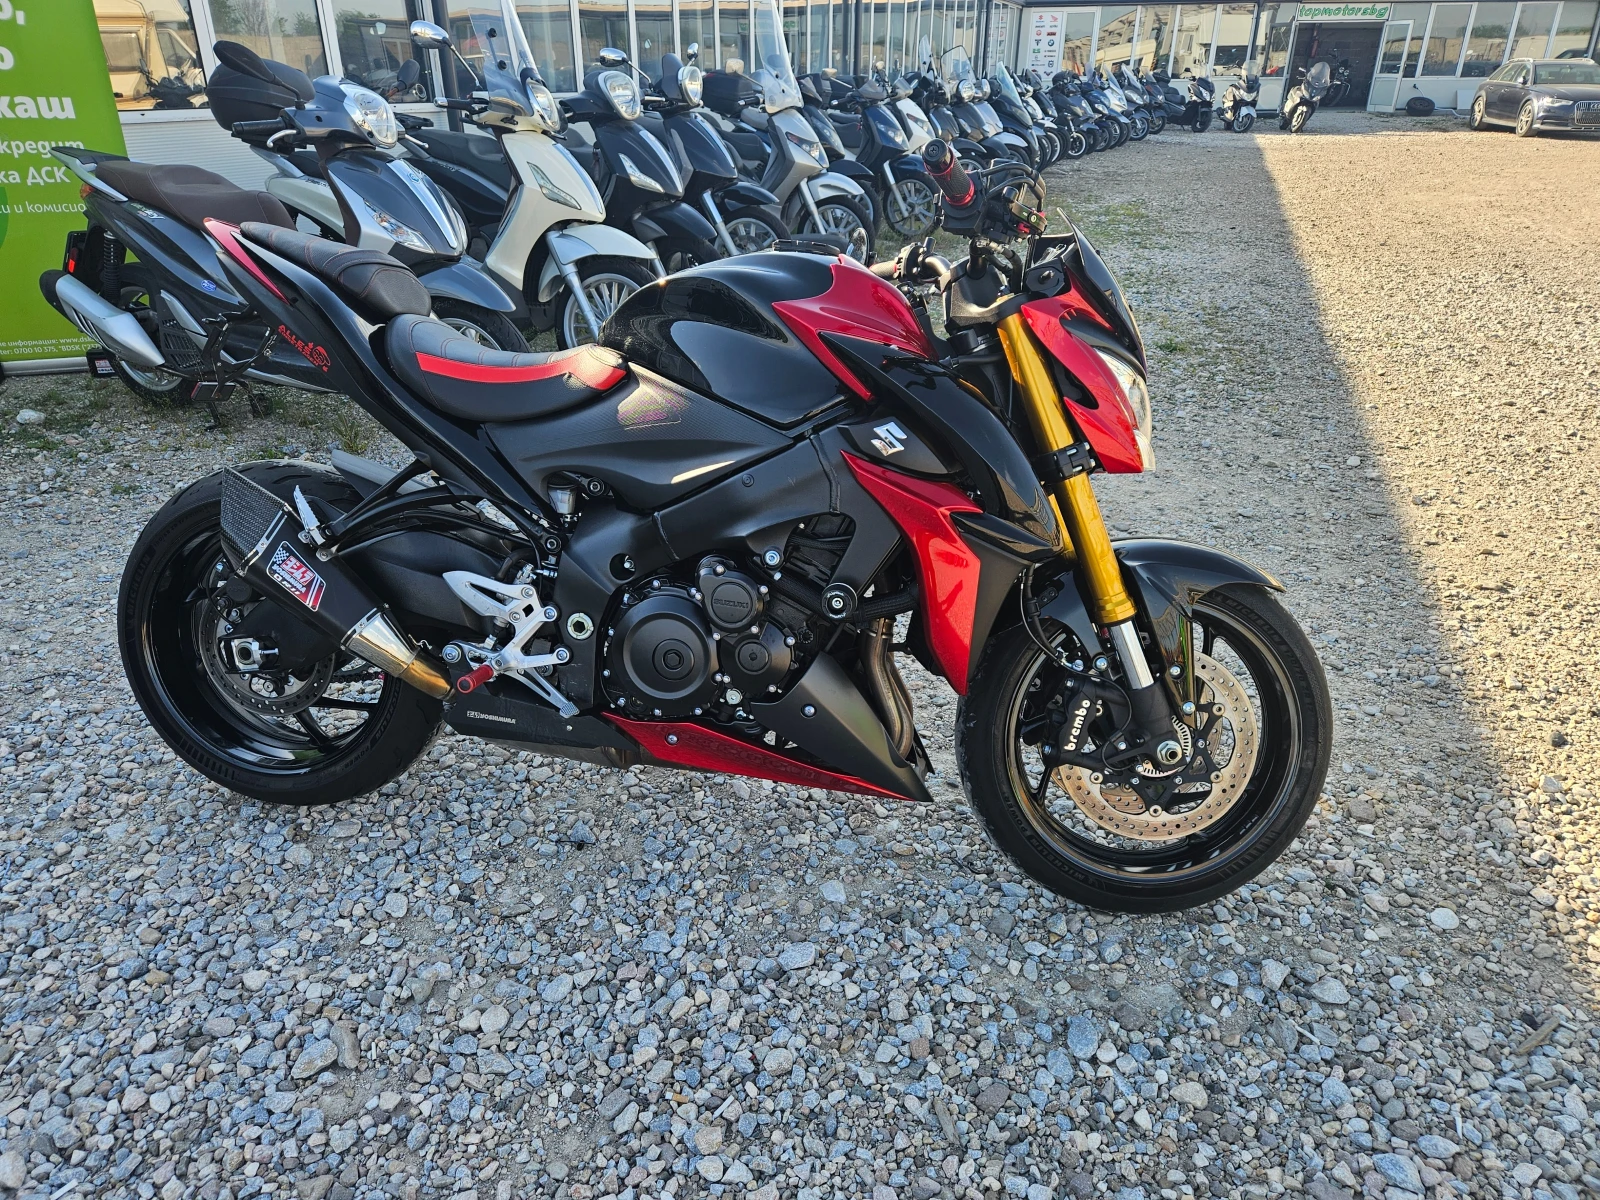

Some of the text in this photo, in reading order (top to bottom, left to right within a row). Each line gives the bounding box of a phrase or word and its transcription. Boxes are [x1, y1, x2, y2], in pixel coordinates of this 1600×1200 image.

[1300, 4, 1389, 19] topmotorsbg
[26, 166, 71, 186] ДСК
[14, 204, 23, 213] и
[278, 325, 312, 355] ALLES
[713, 598, 749, 609] SUZUKI
[1063, 699, 1091, 751] brembo
